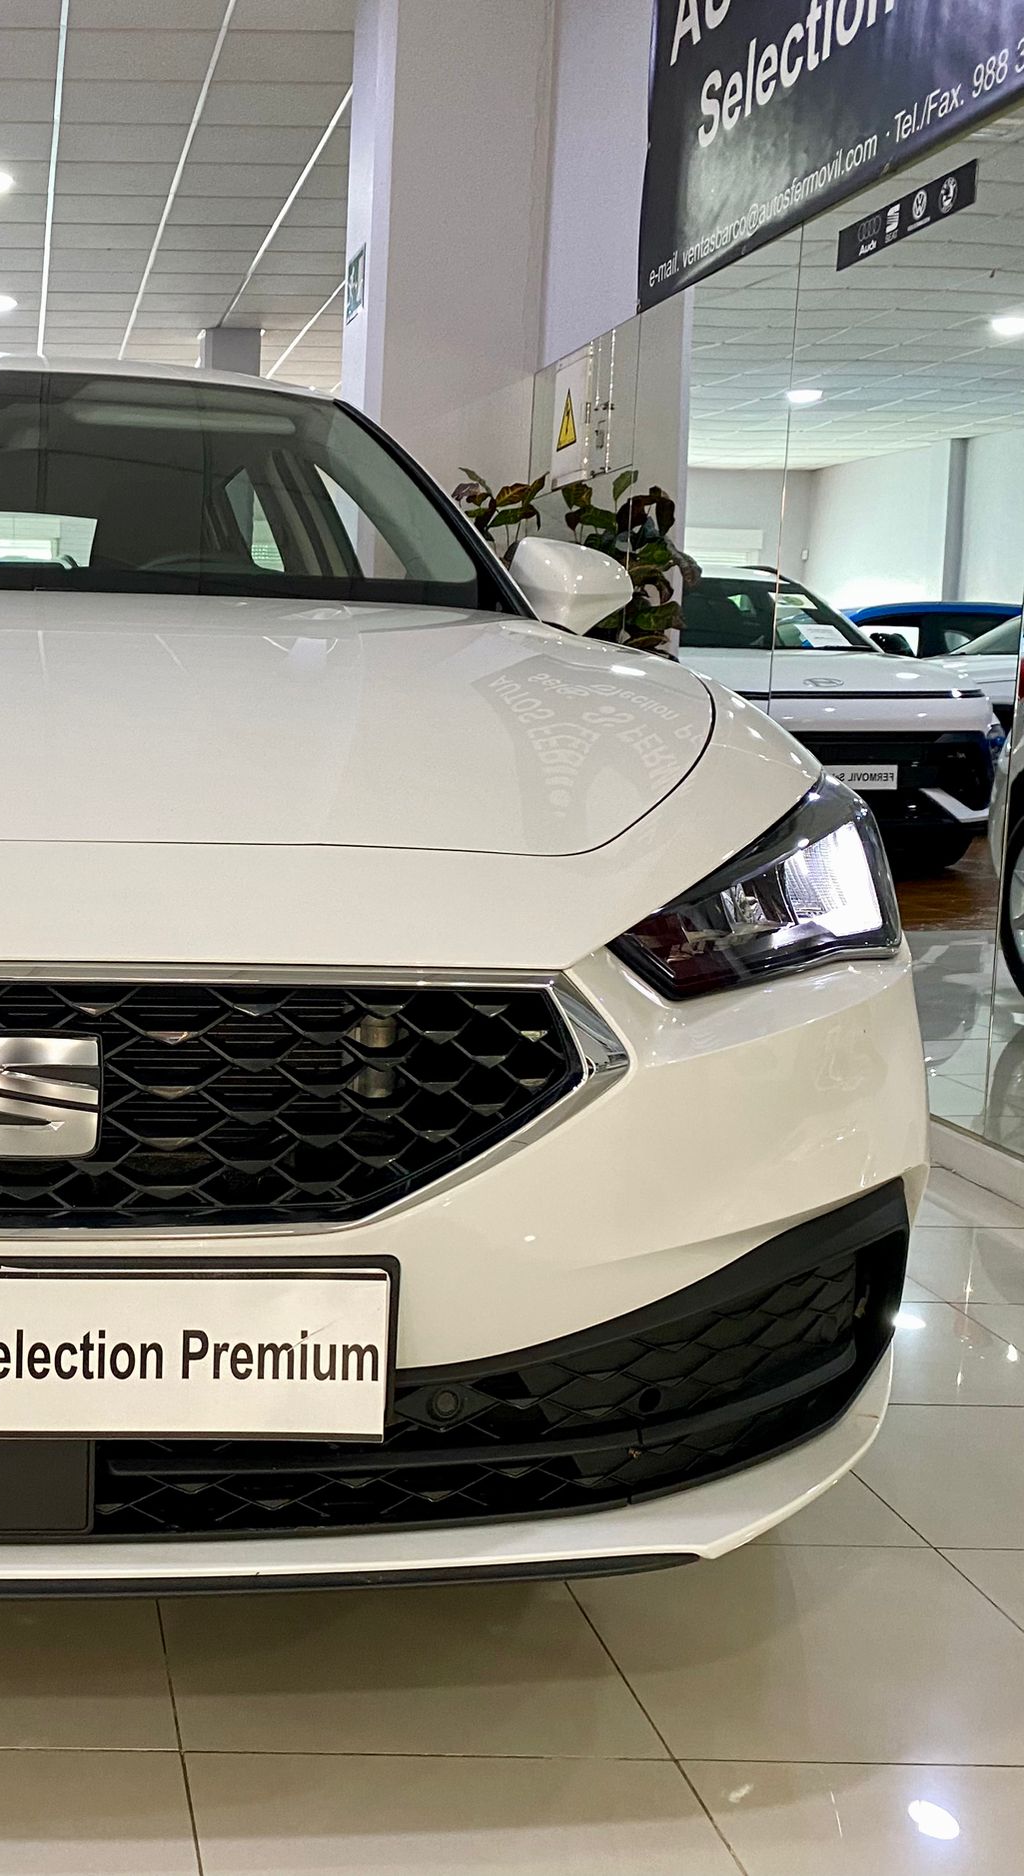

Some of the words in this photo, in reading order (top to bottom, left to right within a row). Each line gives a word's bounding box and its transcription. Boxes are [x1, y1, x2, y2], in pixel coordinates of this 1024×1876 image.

[682, 134, 878, 268] ventasbarco@autosfermovil.com
[894, 83, 964, 143] Tel./Fax.
[972, 48, 1009, 97] 988
[181, 1328, 379, 1382] Premium
